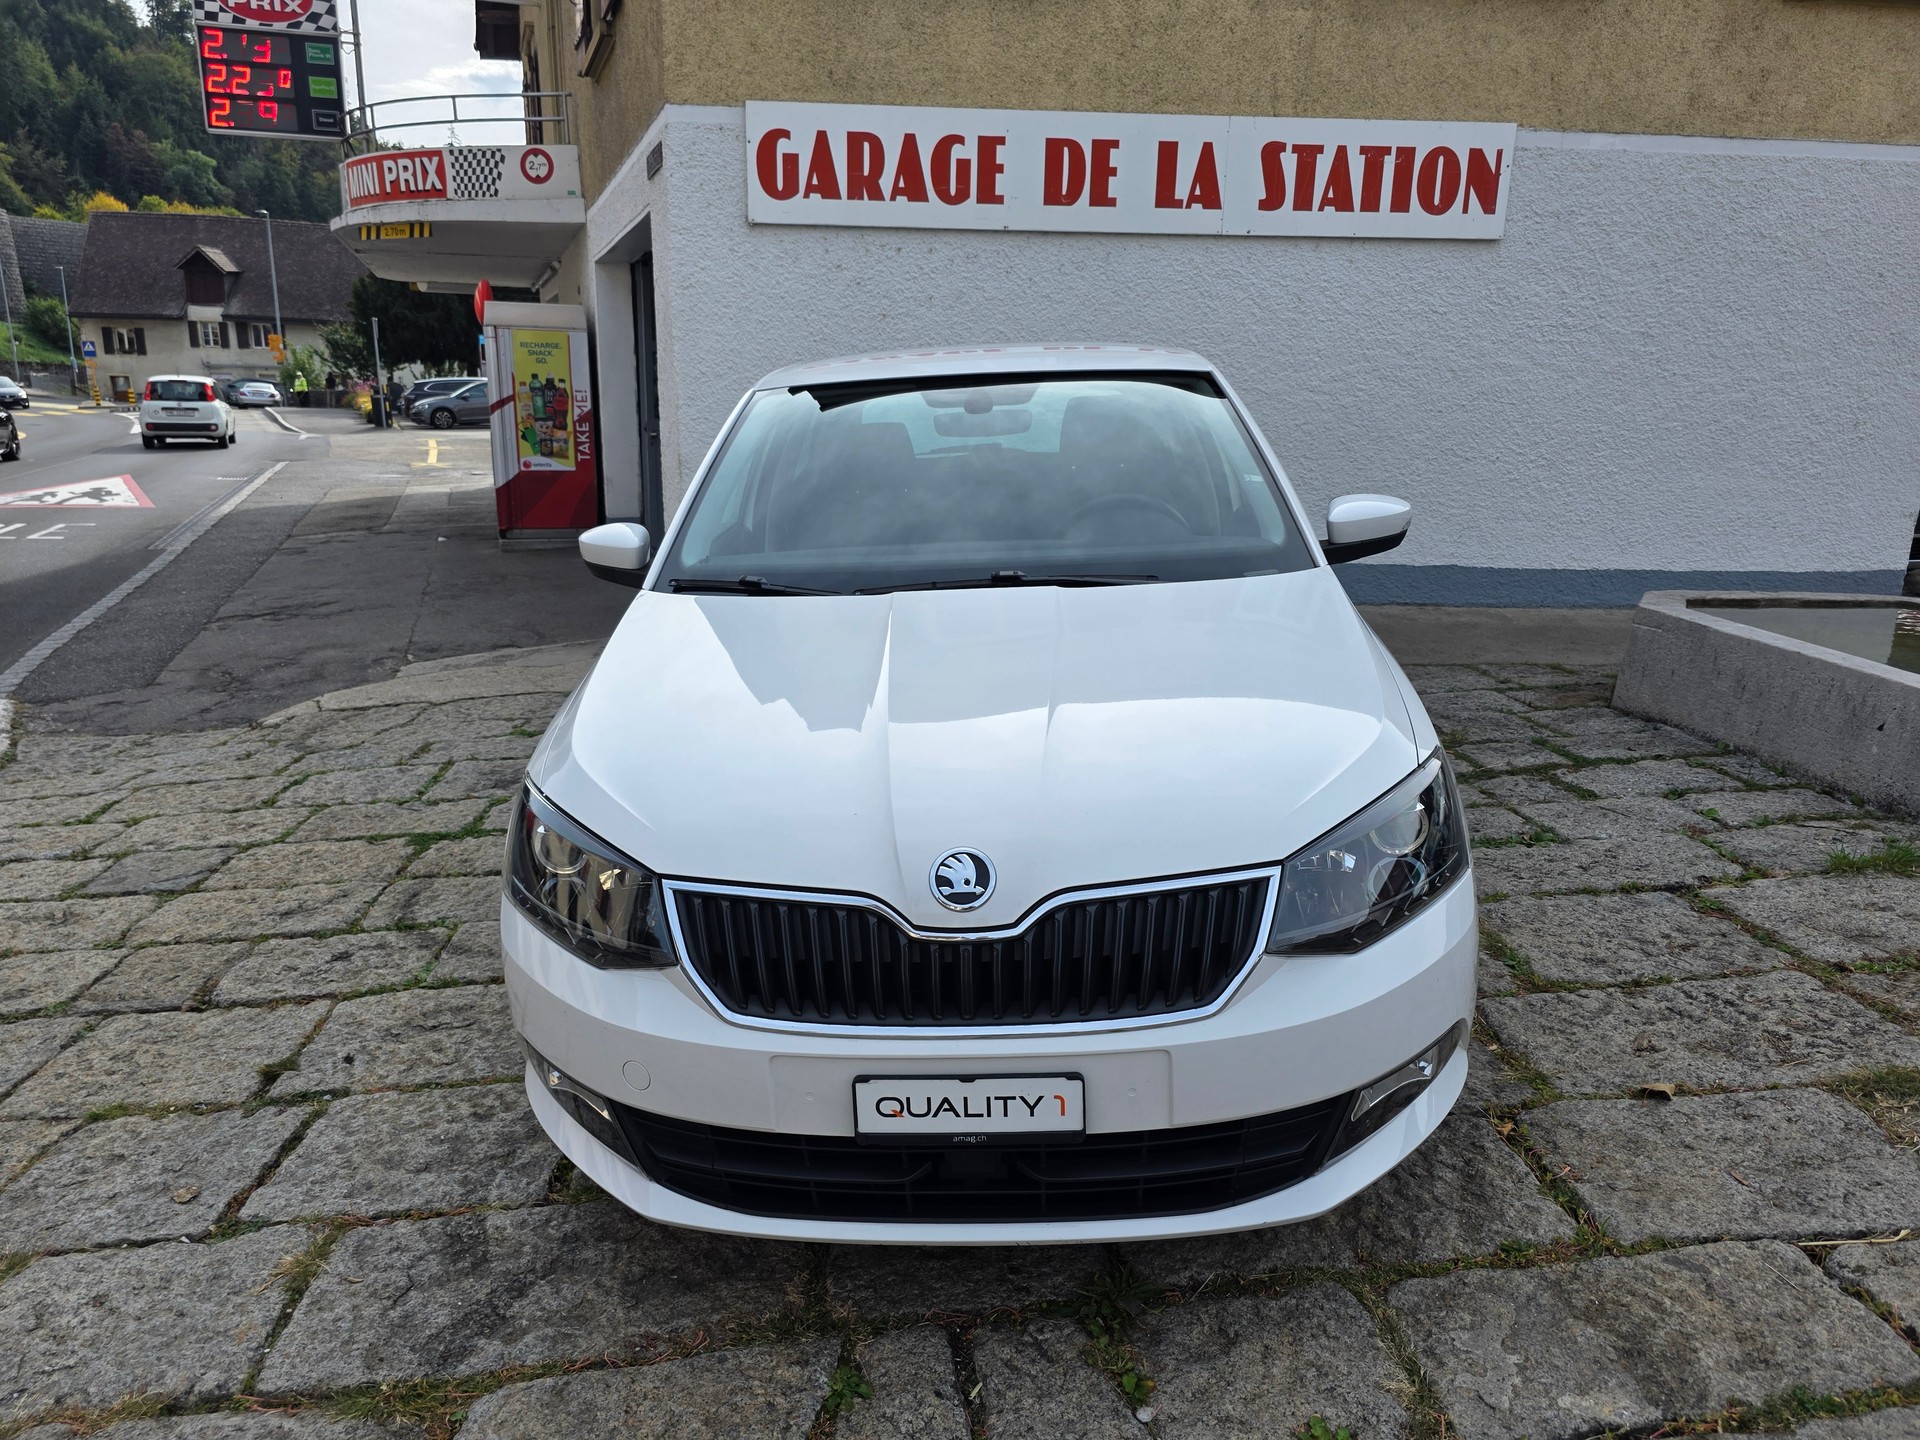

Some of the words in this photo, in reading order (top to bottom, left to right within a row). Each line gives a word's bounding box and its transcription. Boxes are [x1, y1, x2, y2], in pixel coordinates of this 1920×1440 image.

[348, 161, 380, 199] MINI
[382, 156, 443, 193] PRIX
[756, 128, 1006, 206] GARAGE
[1043, 137, 1120, 207] DE
[1154, 140, 1222, 210] LA
[1257, 140, 1504, 216] STATION
[520, 341, 562, 350] RECHARGE.
[527, 349, 554, 357] SNACK.
[575, 390, 588, 418] ME!
[576, 422, 591, 462] TAKE
[875, 1095, 1045, 1118] QUALITY
[1053, 1094, 1066, 1117] 1
[952, 1134, 987, 1143] amag.ch
